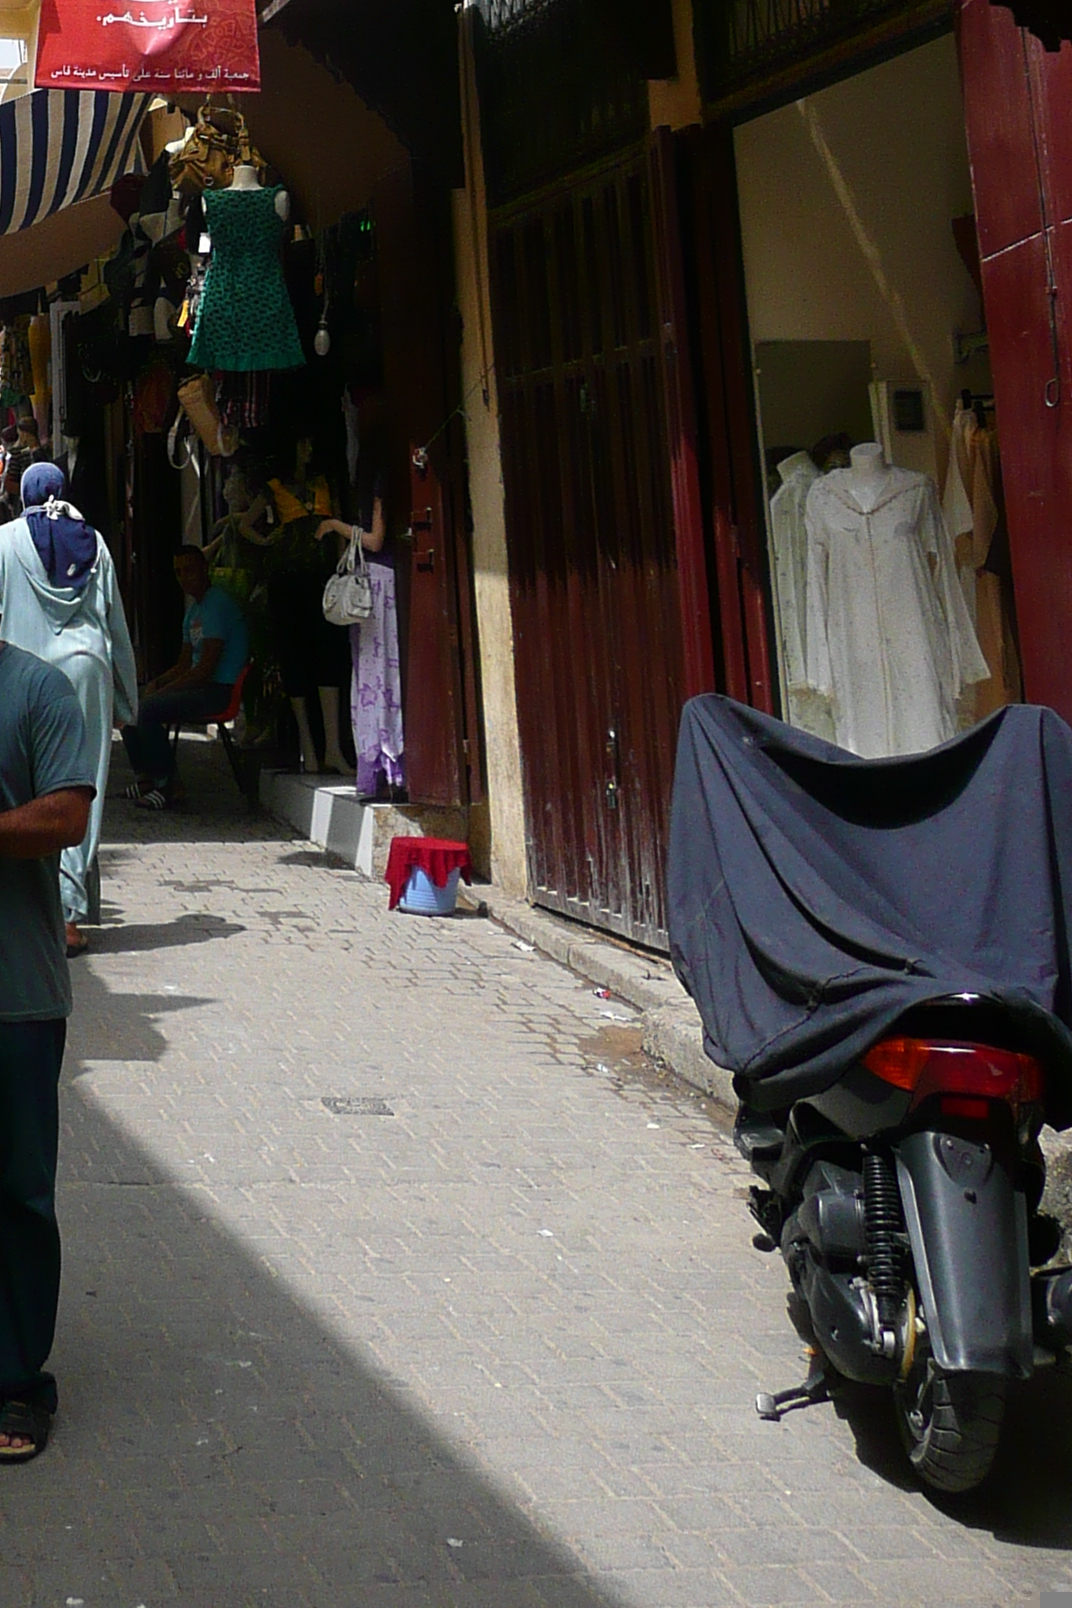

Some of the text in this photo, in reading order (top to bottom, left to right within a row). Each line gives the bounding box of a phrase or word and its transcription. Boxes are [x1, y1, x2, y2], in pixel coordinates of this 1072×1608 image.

[96, 6, 208, 30] بتاريخهم.
[50, 64, 71, 79] فاس
[73, 65, 97, 79] مدينة
[98, 63, 130, 80] تأسيس
[132, 65, 151, 82] على
[153, 68, 171, 79] سنة
[196, 72, 203, 81] و
[204, 65, 222, 79] ألف
[223, 68, 250, 81] جمعية
